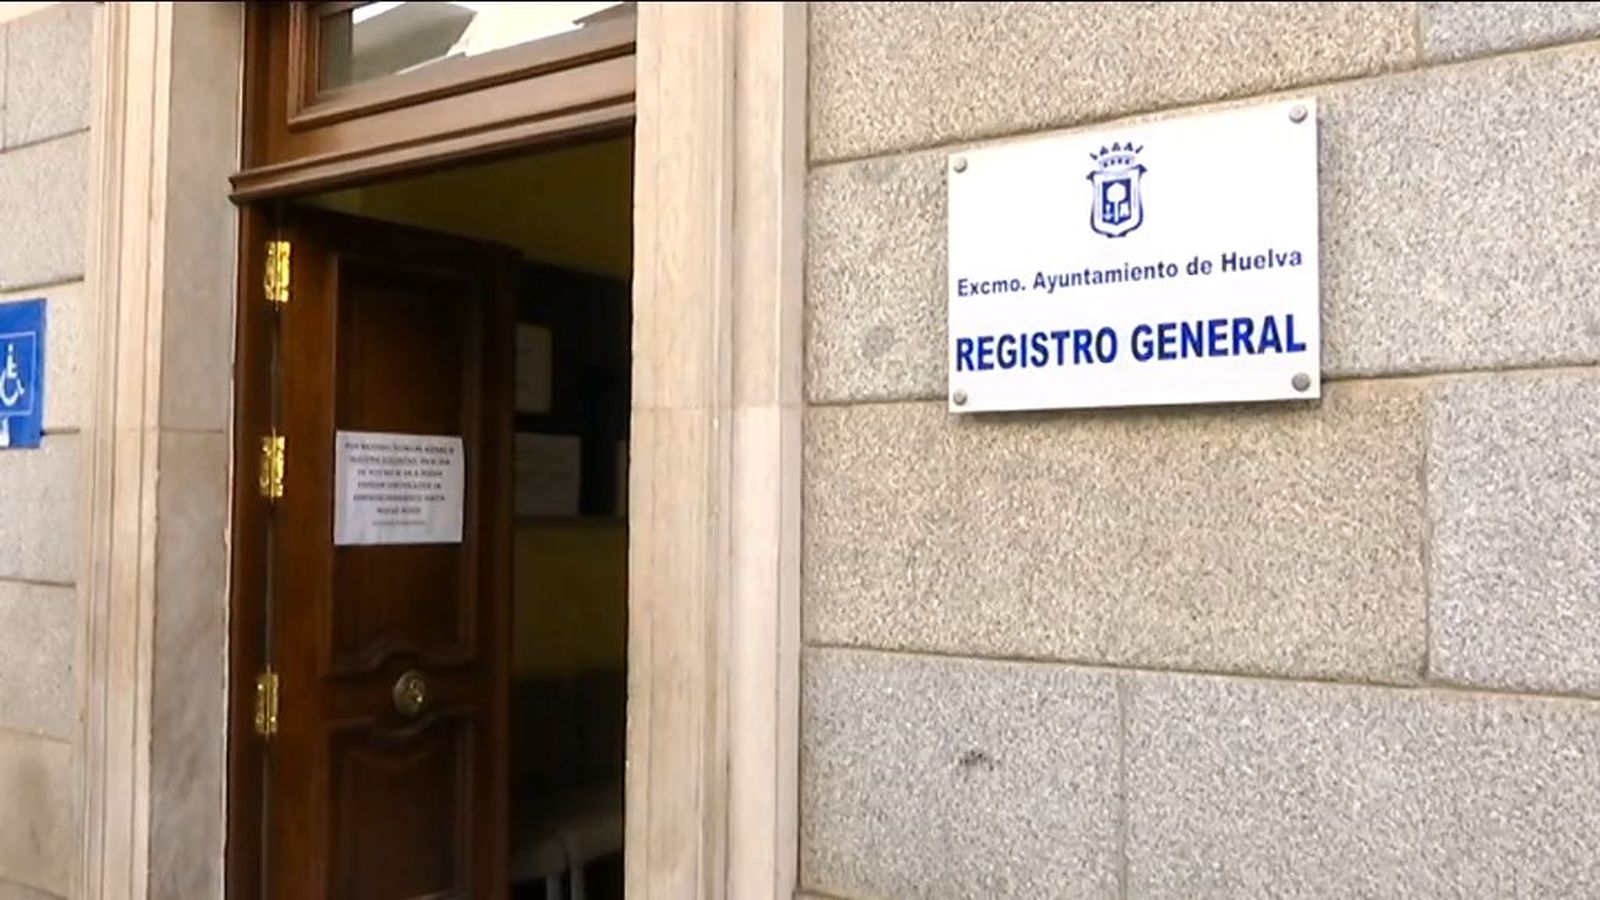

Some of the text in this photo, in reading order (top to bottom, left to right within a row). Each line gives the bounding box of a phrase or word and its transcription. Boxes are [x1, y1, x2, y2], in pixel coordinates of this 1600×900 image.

[957, 249, 1303, 297] Excmo. Ayuntamiento de Huelva
[956, 313, 1307, 372] REGISTRO GENERAL
